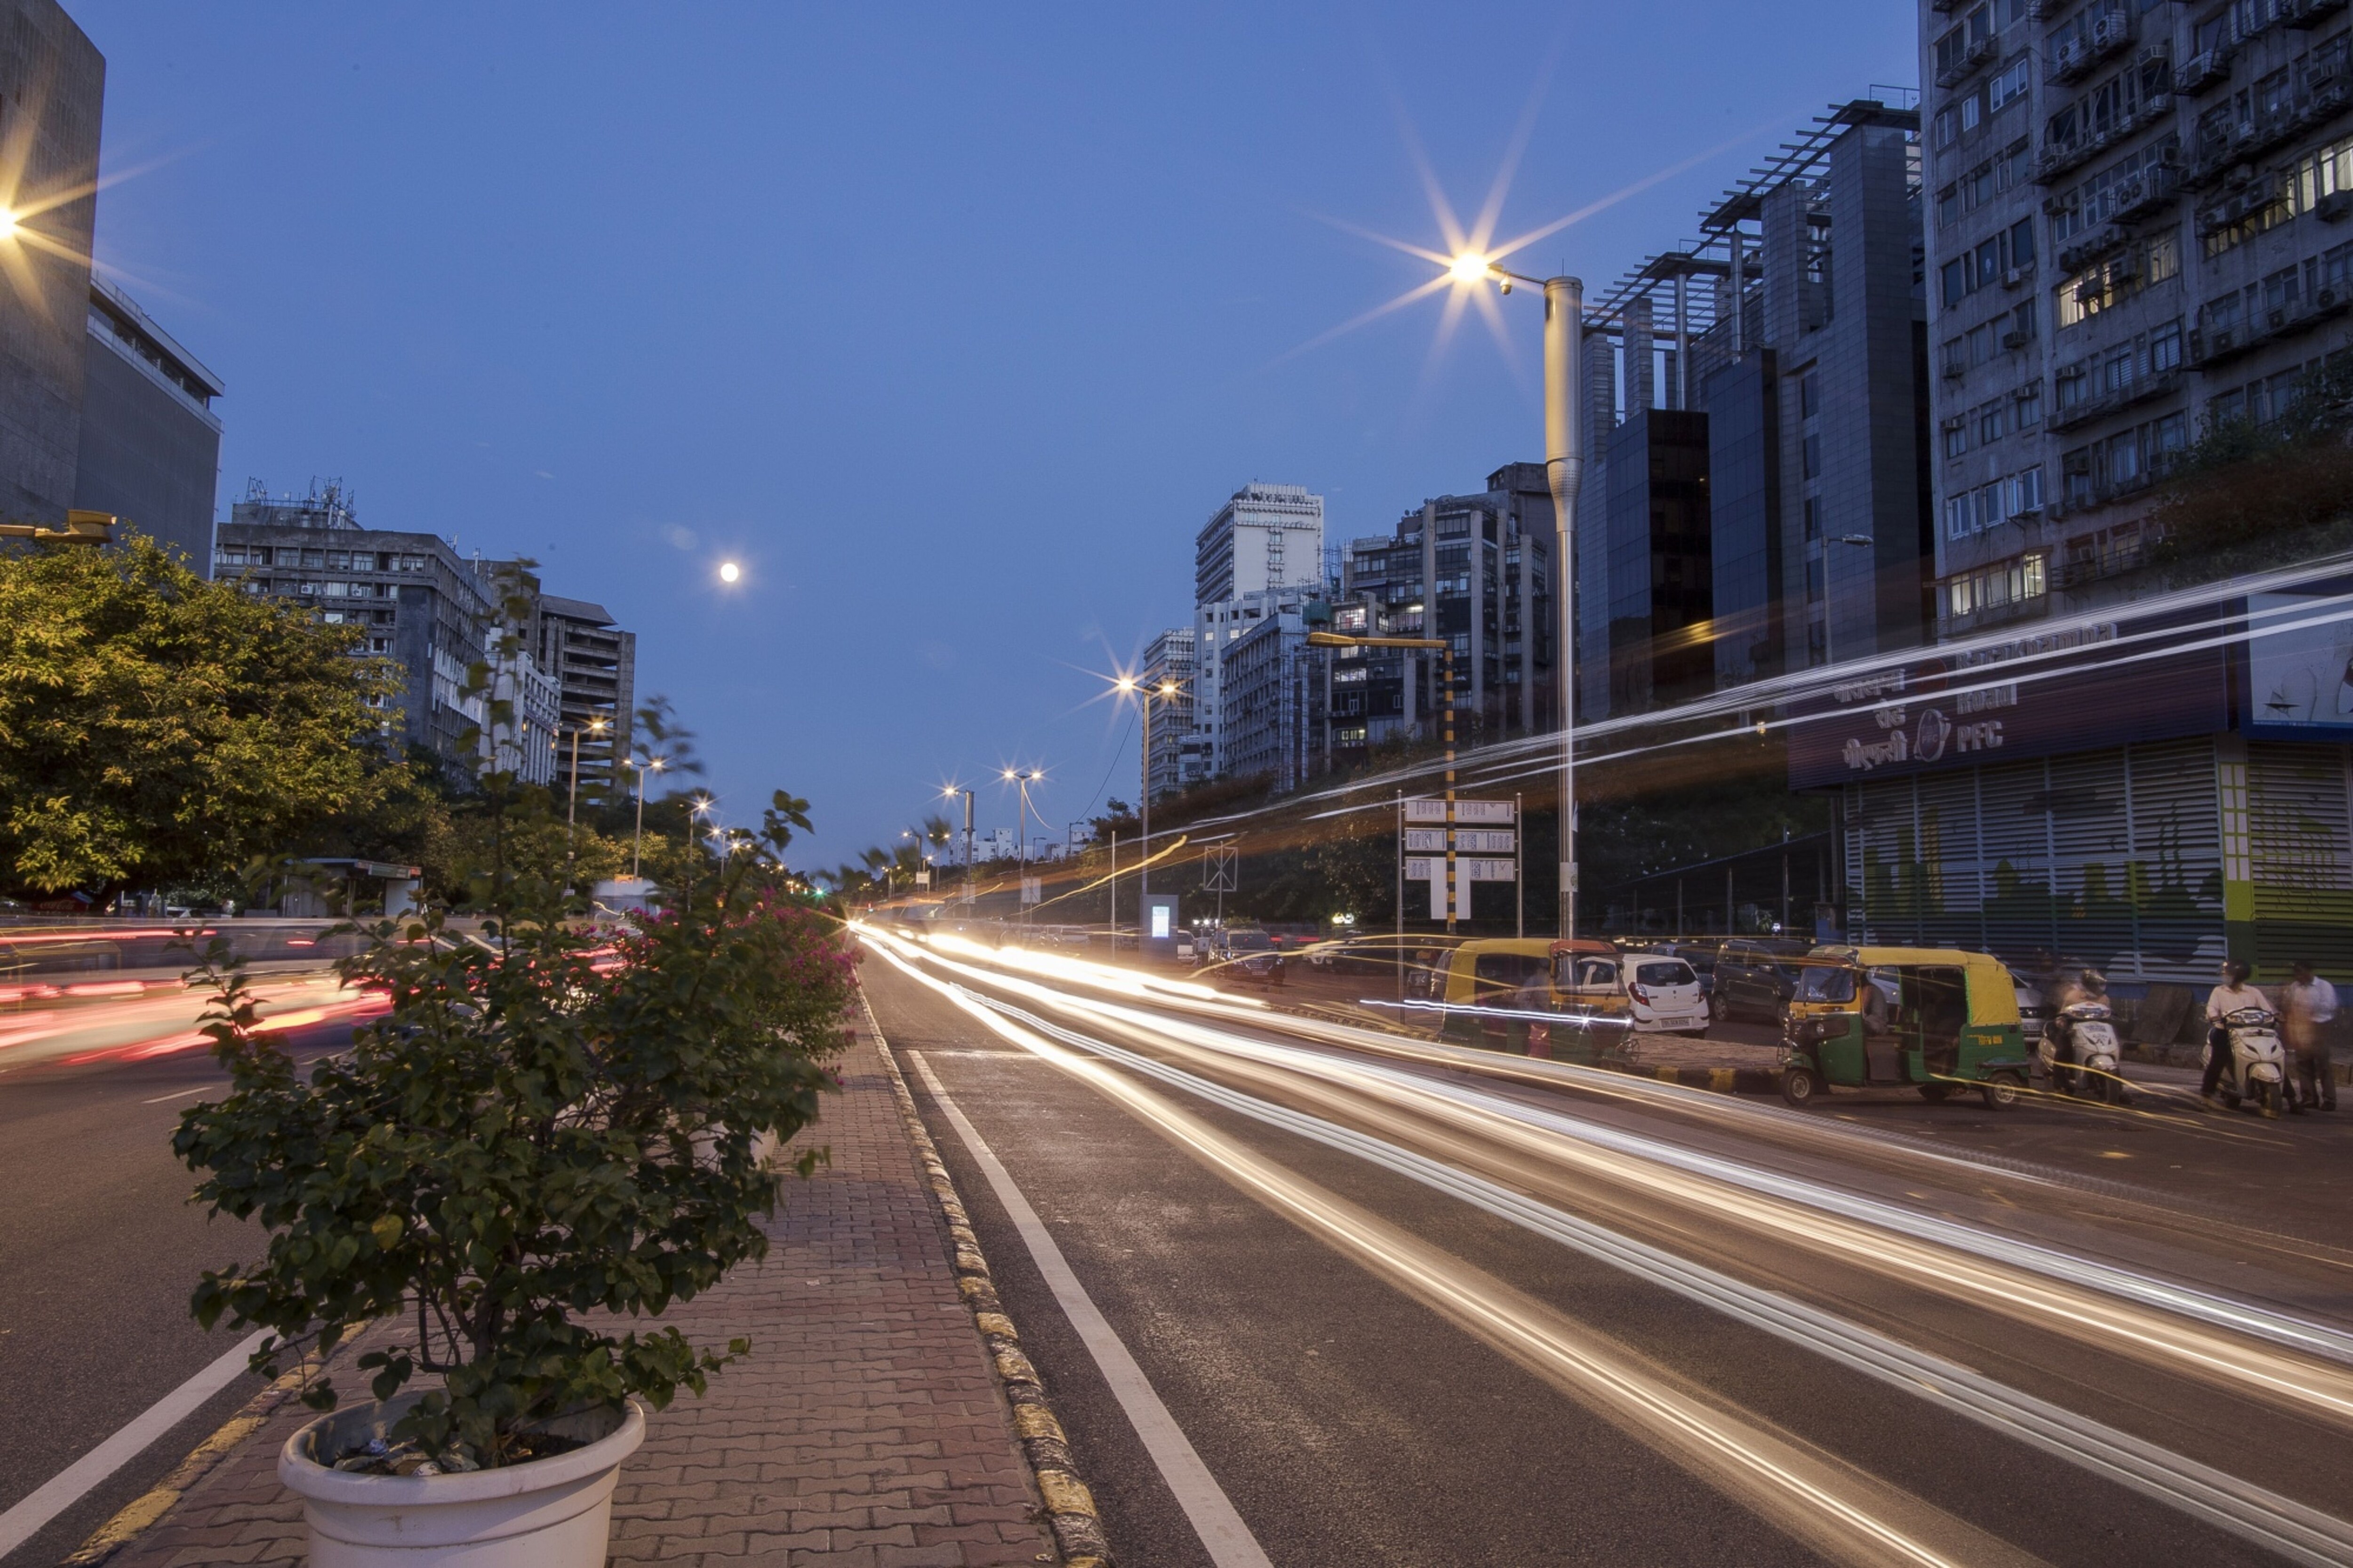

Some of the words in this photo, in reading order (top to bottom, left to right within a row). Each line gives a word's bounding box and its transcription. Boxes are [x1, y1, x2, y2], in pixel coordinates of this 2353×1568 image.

[1957, 683, 2017, 714] Road
[1842, 730, 1907, 771] पीएफसी
[1921, 734, 1938, 744] PFC
[1957, 720, 2003, 752] PFC
